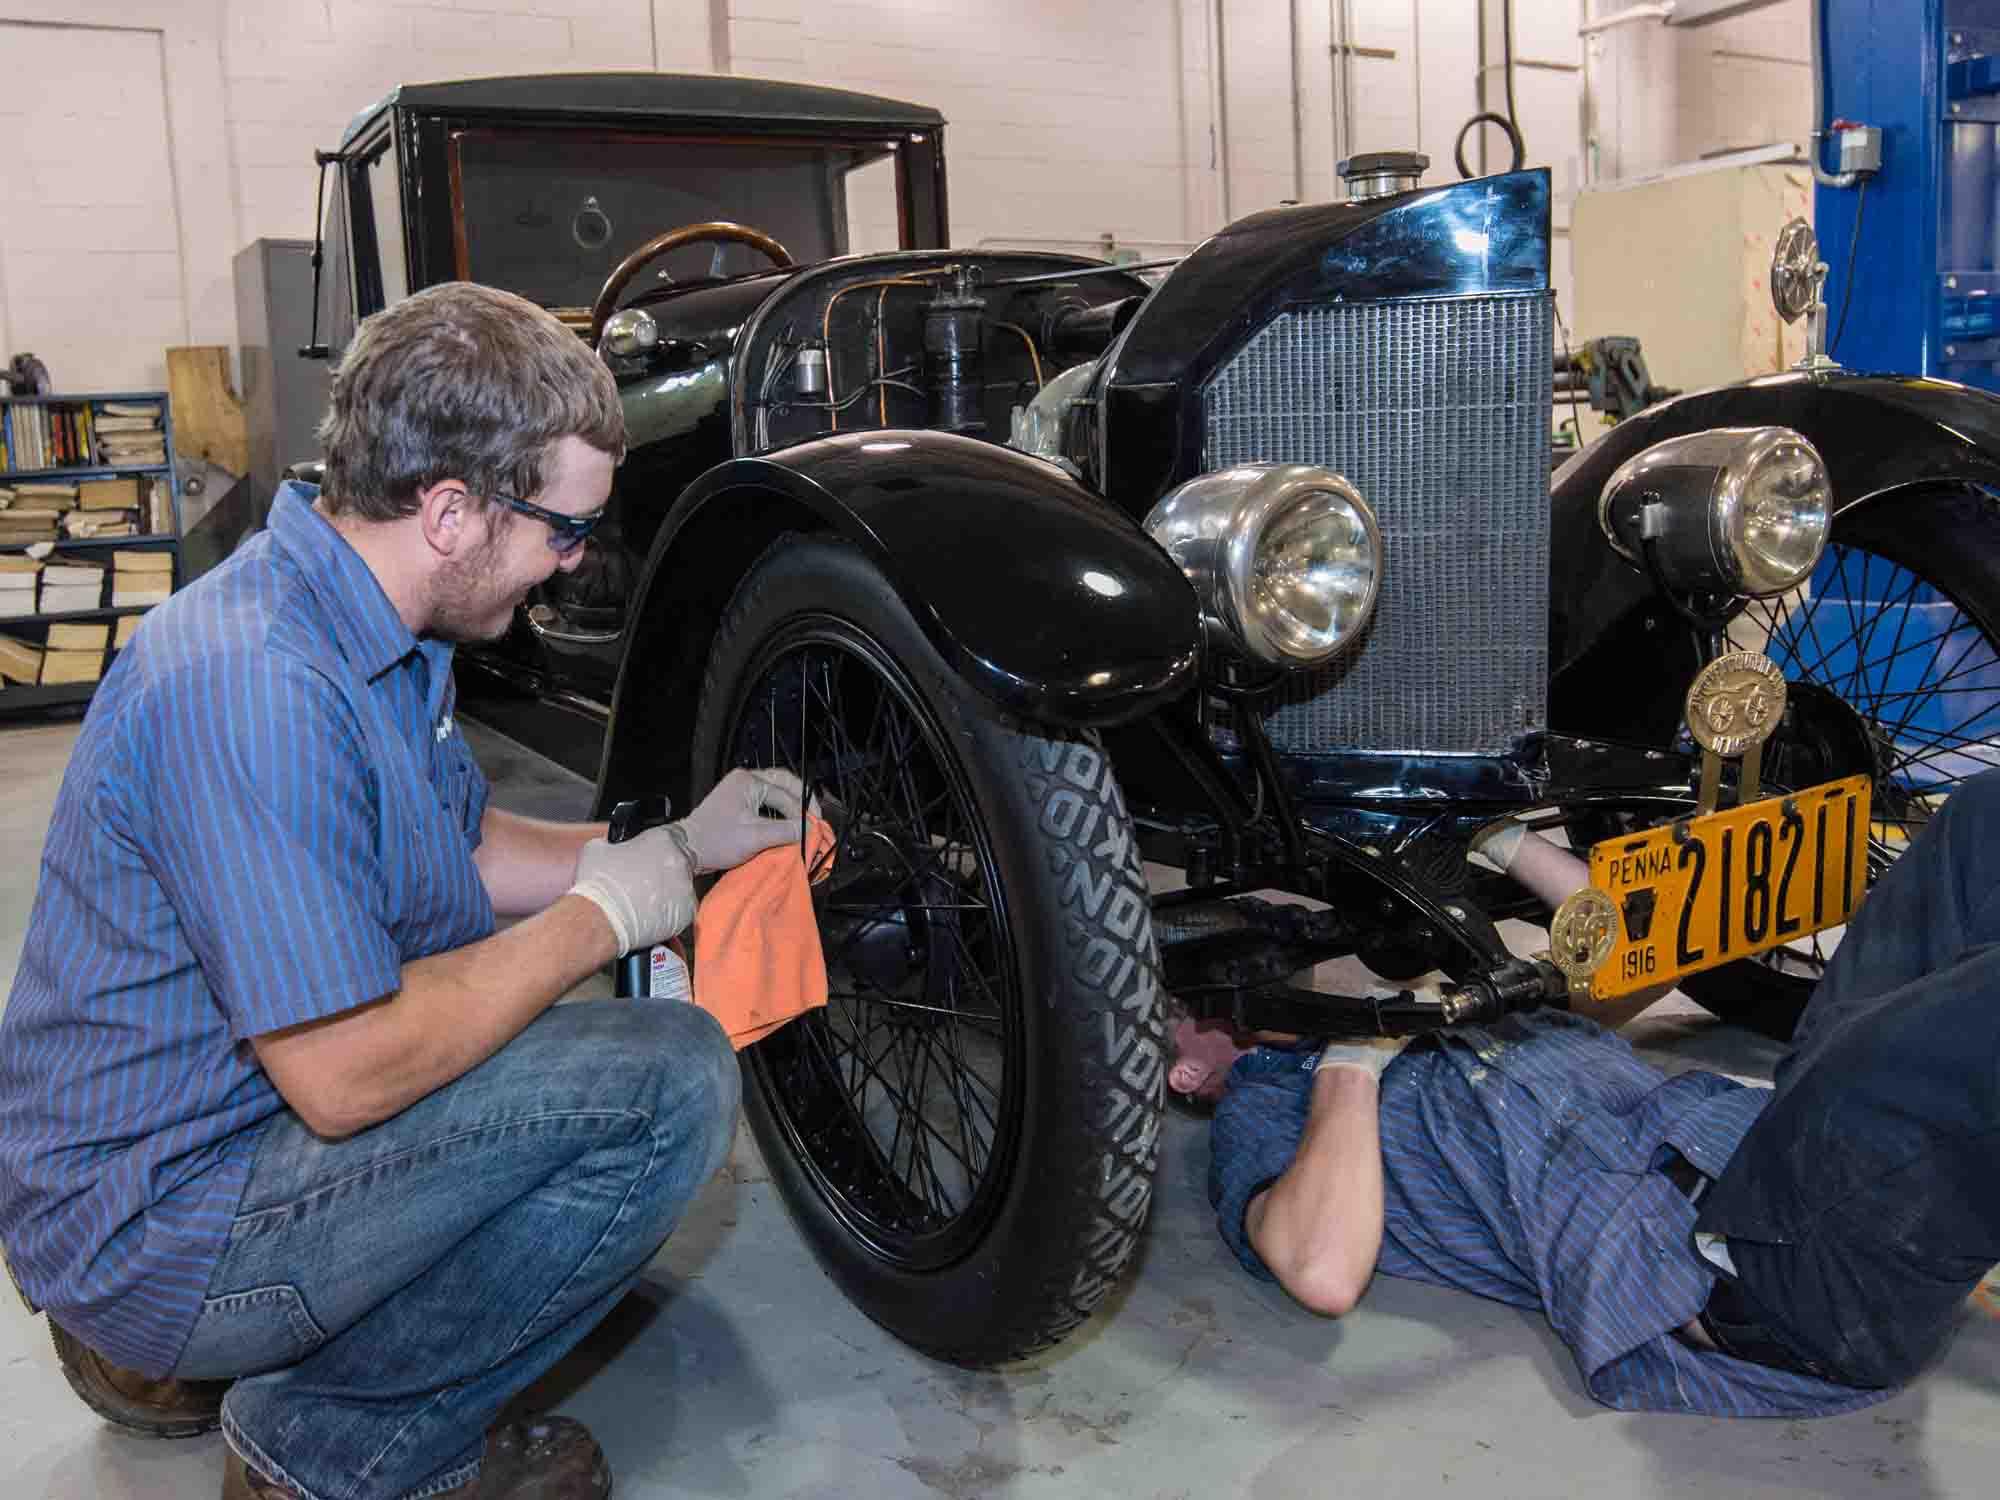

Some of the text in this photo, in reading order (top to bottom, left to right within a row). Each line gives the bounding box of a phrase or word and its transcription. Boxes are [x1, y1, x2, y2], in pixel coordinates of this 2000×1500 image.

[1609, 846, 1672, 889] PENNA
[1677, 795, 1857, 967] 218211
[1622, 945, 1656, 982] 1916
